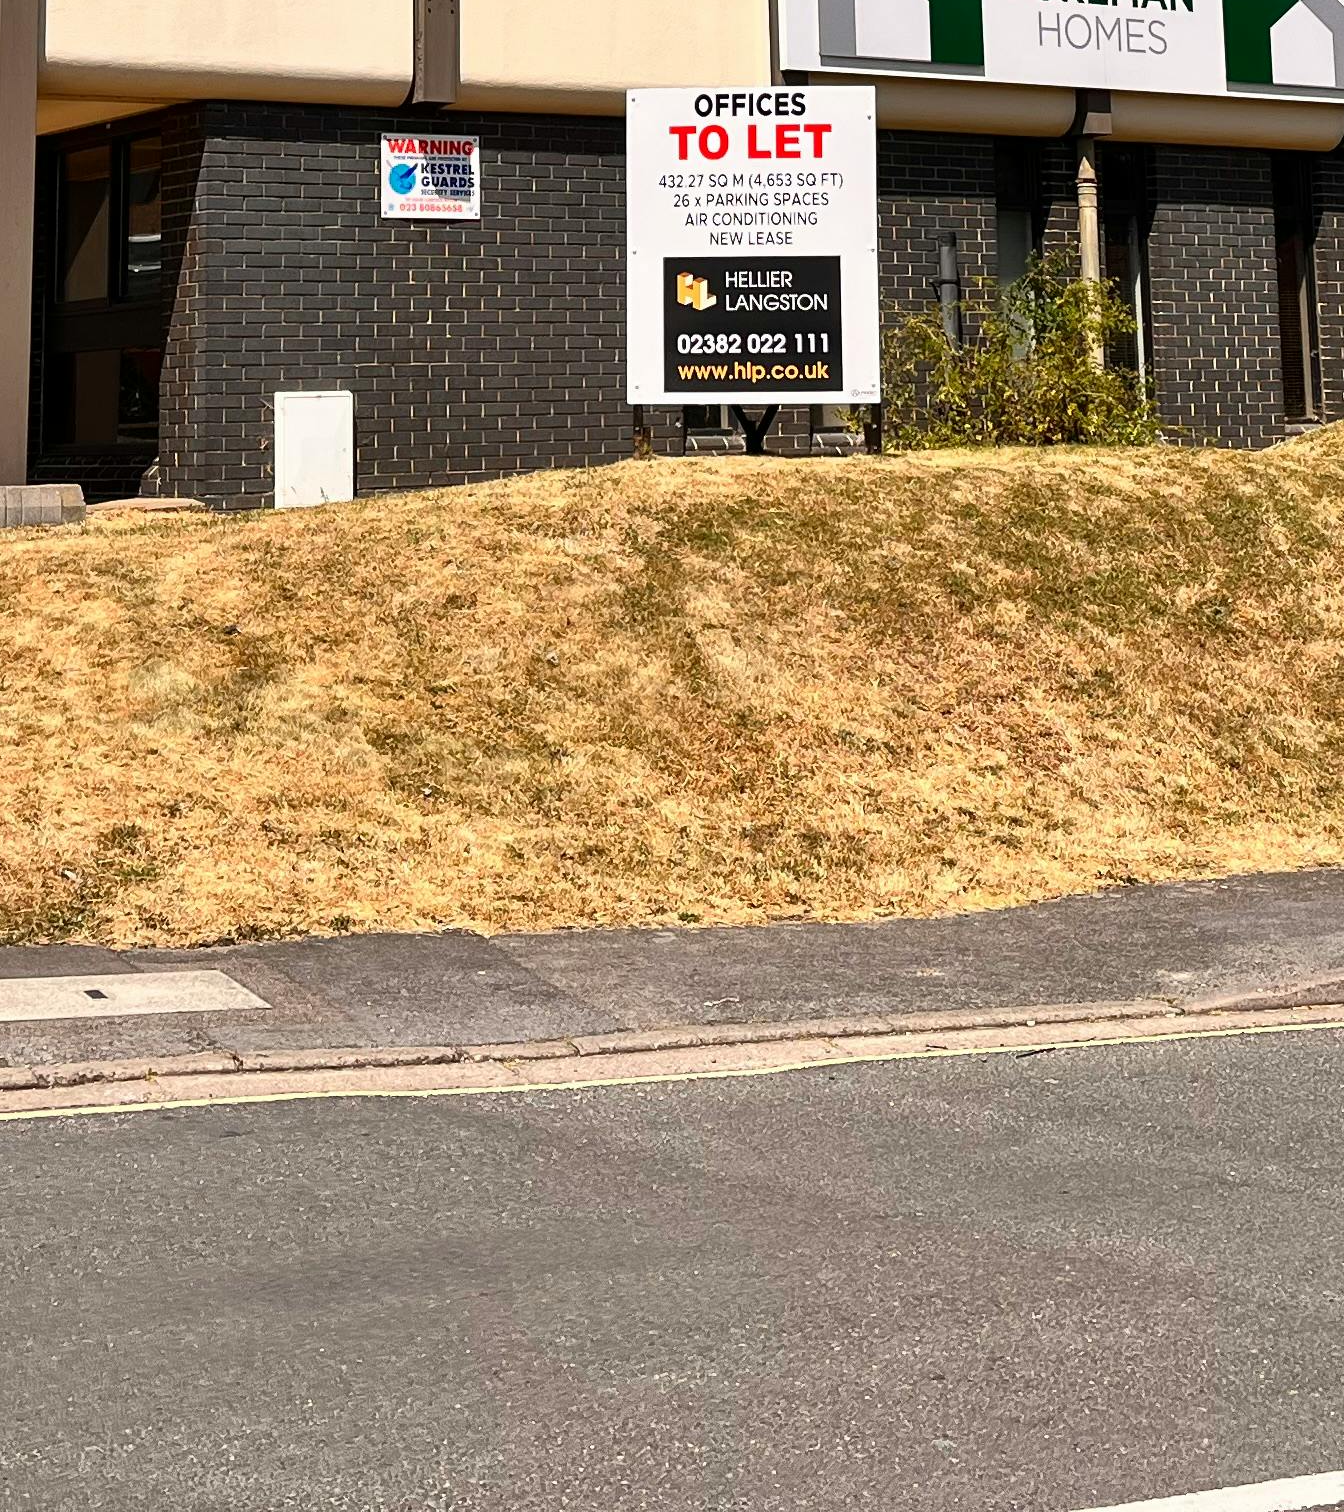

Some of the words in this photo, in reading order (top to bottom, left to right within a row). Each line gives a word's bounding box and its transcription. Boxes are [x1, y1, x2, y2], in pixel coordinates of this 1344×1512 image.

[1038, 11, 1168, 55] HOMES
[694, 93, 806, 117] OFFICES
[387, 138, 474, 156] WARNING
[669, 125, 729, 160] TO
[747, 124, 832, 159] LET
[421, 163, 474, 175] KESTREL
[421, 177, 475, 188] GUARDS
[659, 174, 704, 188] 432.27
[709, 174, 728, 187] SQ
[733, 174, 744, 187] M
[748, 173, 792, 189] (4,653
[797, 173, 817, 187] SQ
[821, 173, 844, 189] FT)
[399, 204, 416, 212] 023
[673, 194, 690, 207] 26
[706, 193, 769, 207] PARKING
[774, 192, 829, 206] SPACES
[685, 213, 708, 226] AIR
[712, 212, 818, 226] CONDITIONING
[709, 232, 743, 245] NEW
[748, 231, 793, 245] LEASE
[725, 271, 793, 288] HELLIER
[725, 293, 828, 311] LANGSTON
[677, 334, 742, 354] 02382
[747, 333, 787, 354] 022
[795, 332, 829, 353] 111
[677, 361, 829, 383] www.hlp.co.uk
